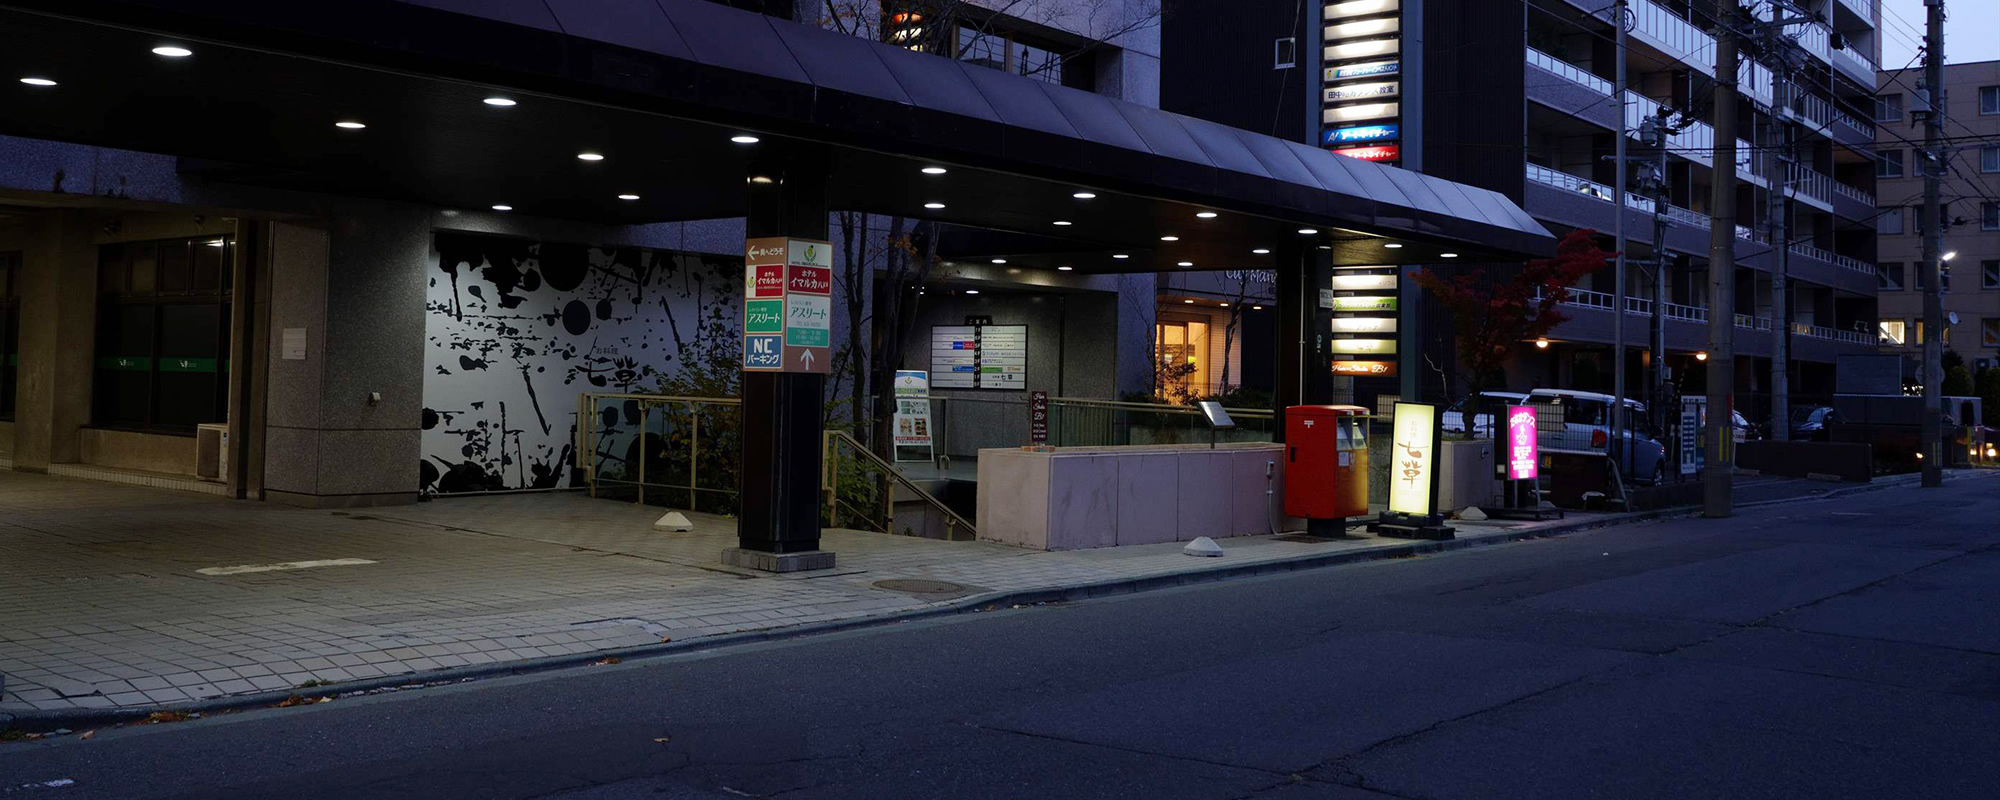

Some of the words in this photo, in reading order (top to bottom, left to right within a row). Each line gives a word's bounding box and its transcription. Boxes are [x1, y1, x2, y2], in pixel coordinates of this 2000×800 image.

[802, 269, 817, 278] ホテル
[748, 312, 781, 324] アスリート
[790, 306, 827, 320] アスリート
[753, 338, 774, 354] NC
[747, 354, 780, 365] パーキング
